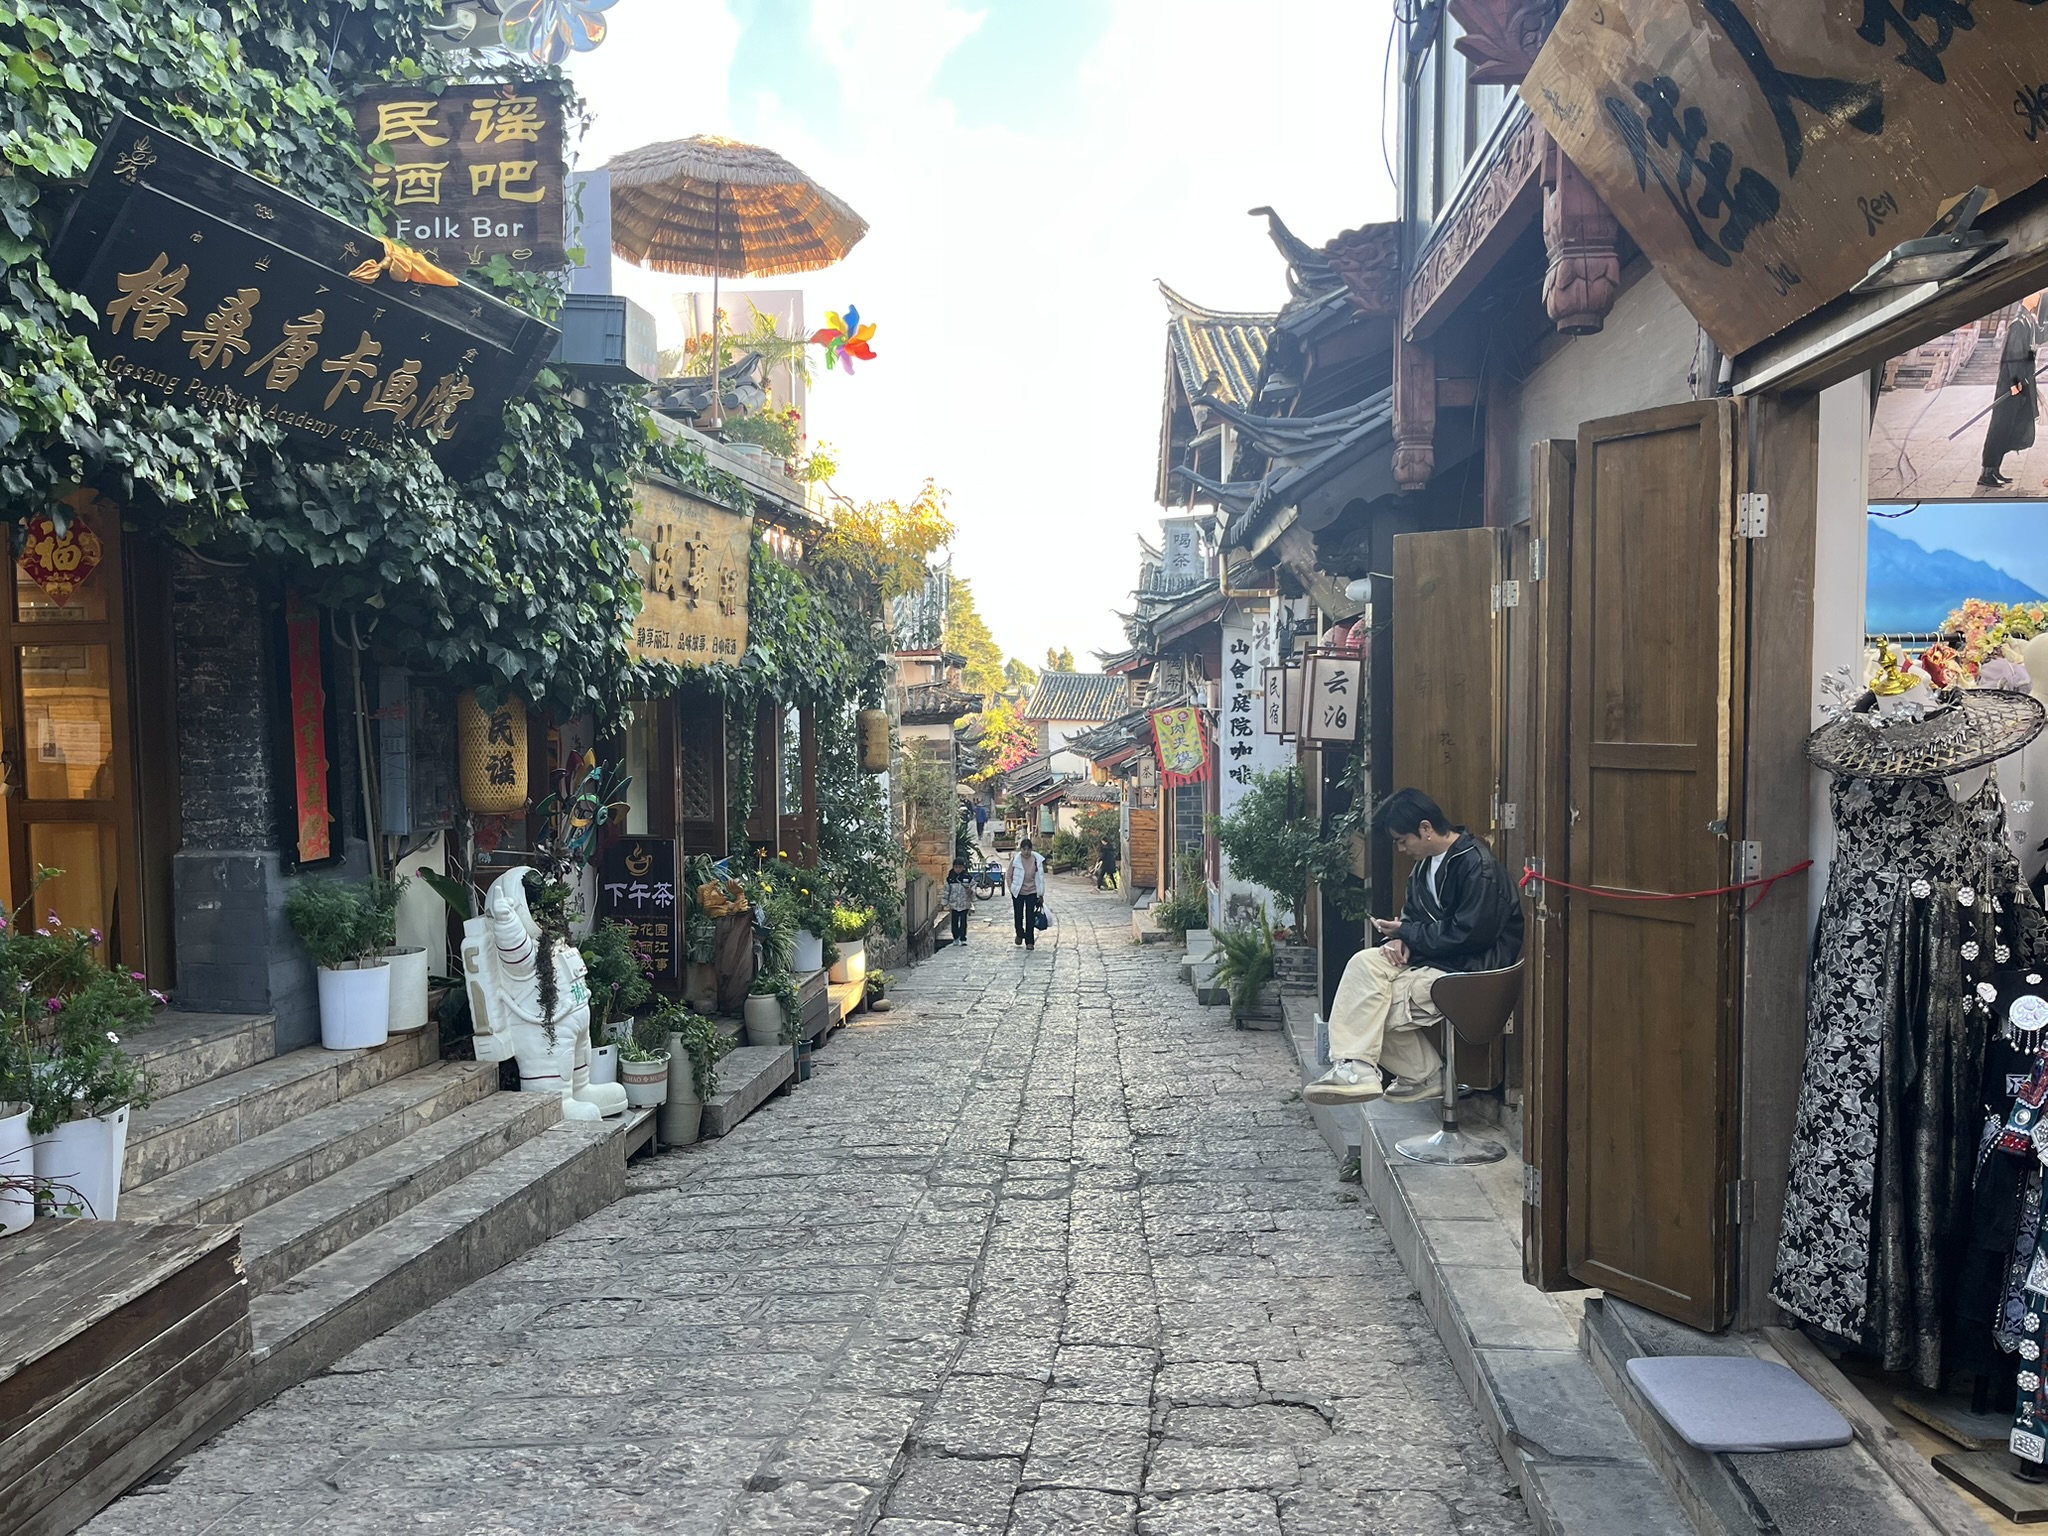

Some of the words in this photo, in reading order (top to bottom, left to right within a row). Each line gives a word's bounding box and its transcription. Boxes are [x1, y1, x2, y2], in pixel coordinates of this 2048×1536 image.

[372, 97, 546, 147] 民谣
[373, 161, 546, 205] 酒吧
[396, 216, 460, 239] Folk
[471, 216, 524, 238] Bar
[108, 355, 180, 395] Gesang
[184, 377, 260, 416] Painin
[264, 403, 338, 439] Academy
[340, 427, 360, 442] of
[35, 521, 82, 572] 福
[1173, 532, 1191, 568] 喝茶
[1269, 676, 1281, 726] 民宿
[1323, 670, 1349, 729] 云泊
[485, 712, 517, 786] 民谣
[1170, 723, 1193, 764] 肉夹馍
[1141, 765, 1153, 779] 茶
[604, 880, 675, 909] 下午茶
